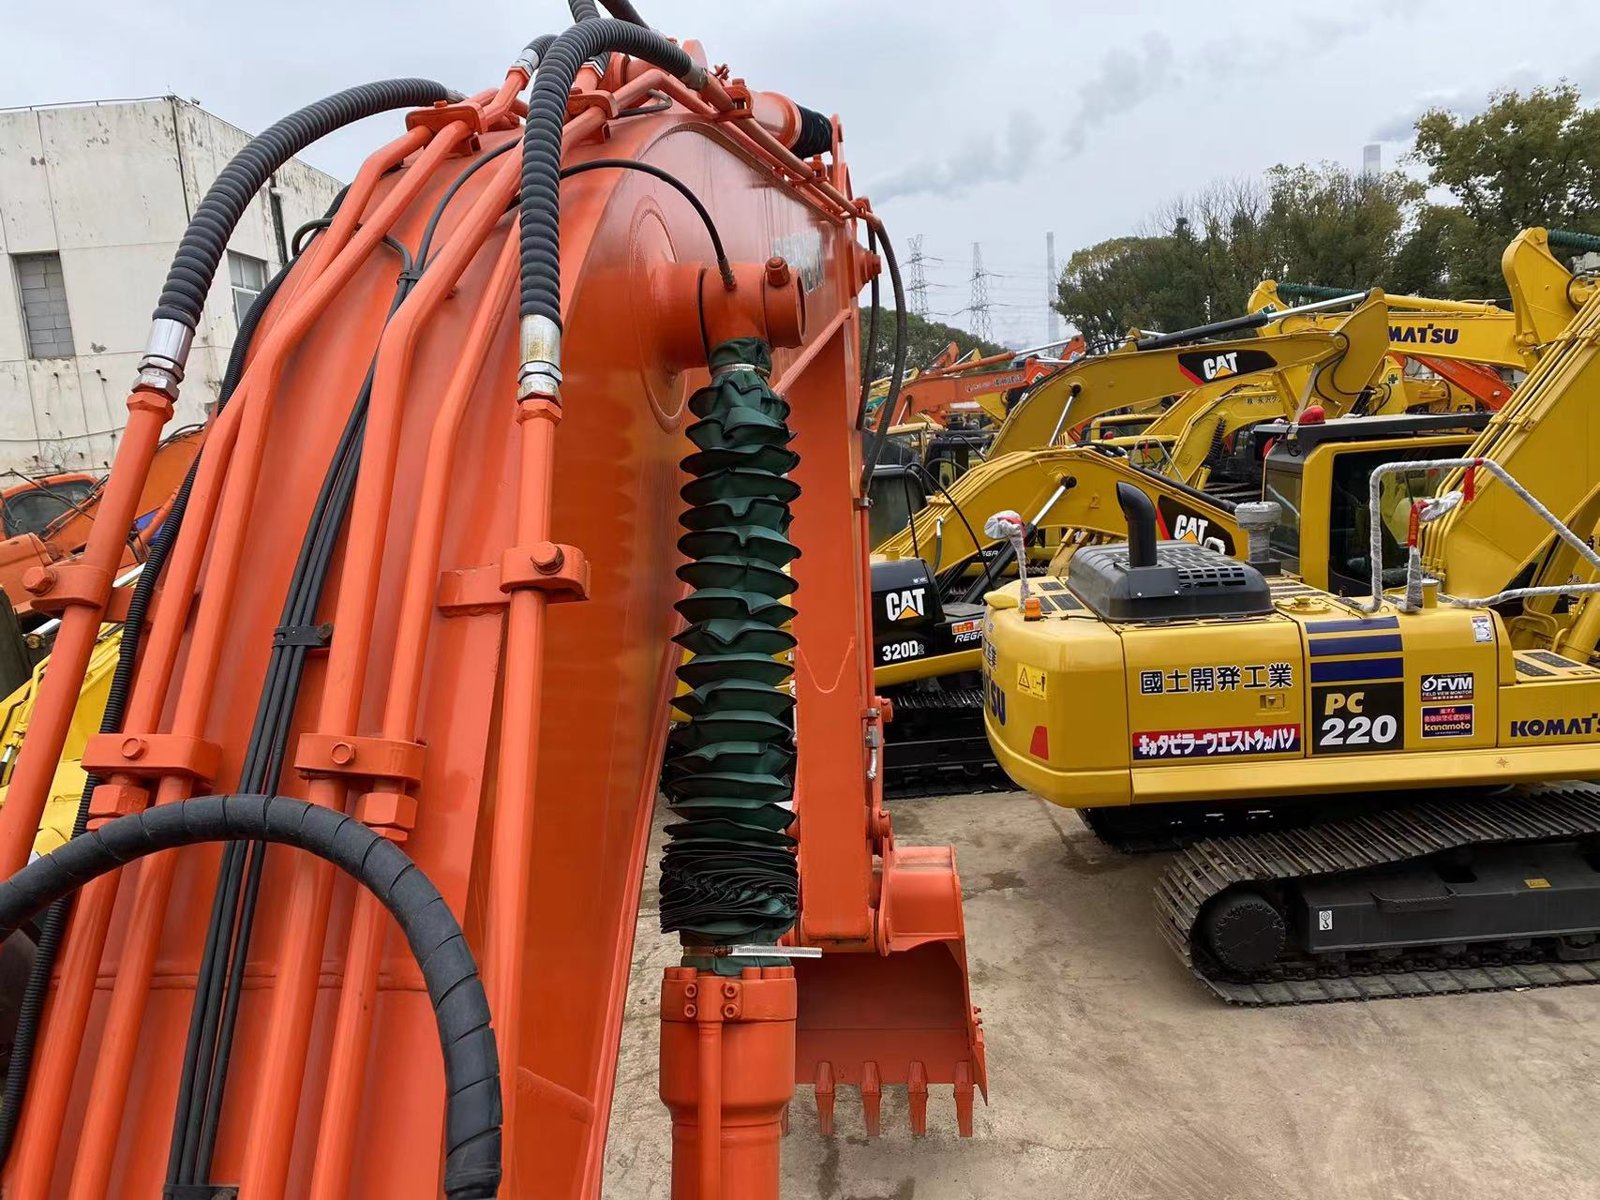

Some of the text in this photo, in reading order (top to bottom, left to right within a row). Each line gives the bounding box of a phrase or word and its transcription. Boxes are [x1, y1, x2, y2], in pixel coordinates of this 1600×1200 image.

[1388, 323, 1459, 344] MATSU
[1203, 352, 1238, 380] CAT
[1174, 514, 1209, 545] CAT
[885, 587, 926, 622] CAT
[1437, 677, 1473, 691] FVM
[1324, 692, 1365, 716] PC
[1319, 714, 1397, 746] 220
[1424, 722, 1471, 732] kanamoto
[1511, 713, 1600, 737] KOMAT
